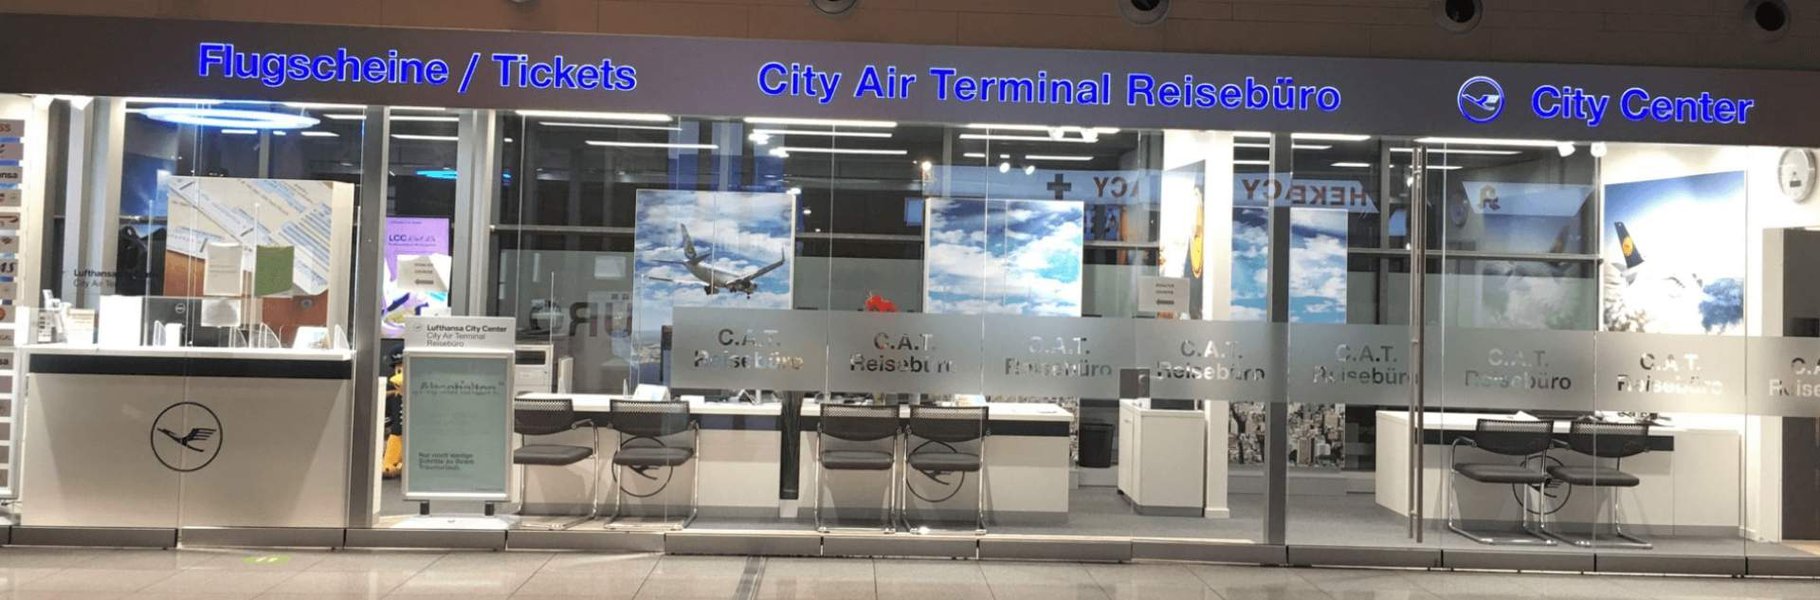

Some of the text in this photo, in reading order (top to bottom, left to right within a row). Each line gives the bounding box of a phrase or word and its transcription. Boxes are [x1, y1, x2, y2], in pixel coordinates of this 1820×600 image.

[197, 42, 637, 94] Flugscheine / Tickets
[757, 62, 1342, 113] City Air Terminal Reisebüro
[1531, 84, 1755, 127] City Center
[427, 324, 464, 332] Lufthansa
[465, 325, 481, 333] City
[874, 332, 936, 351] C.A.T.
[1336, 343, 1398, 362] C.A.T.
